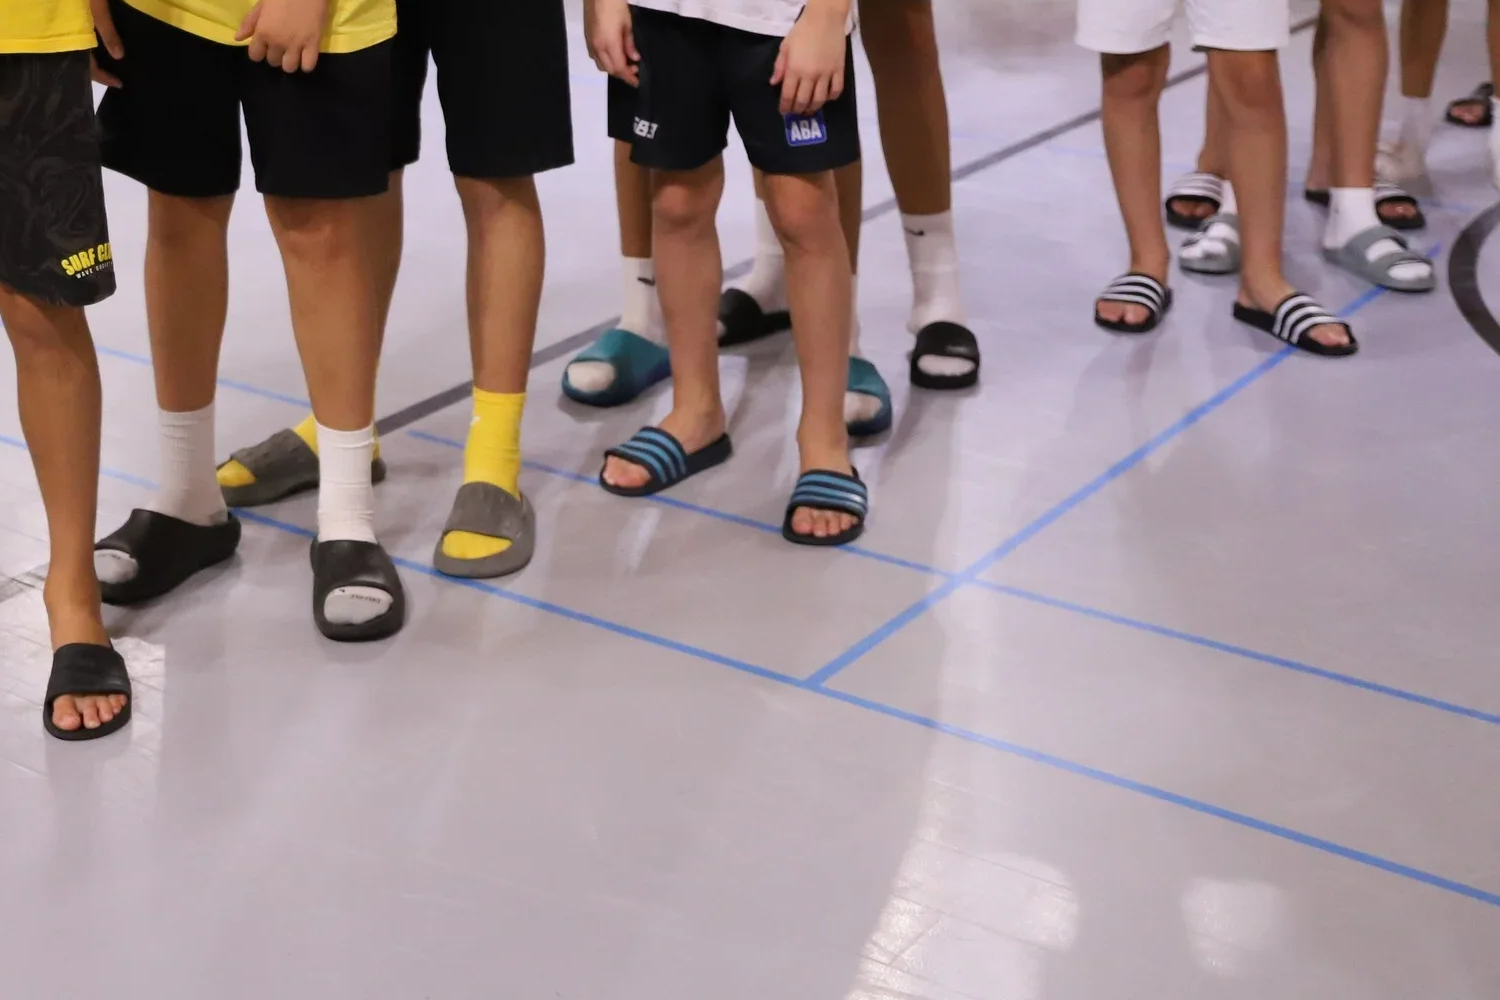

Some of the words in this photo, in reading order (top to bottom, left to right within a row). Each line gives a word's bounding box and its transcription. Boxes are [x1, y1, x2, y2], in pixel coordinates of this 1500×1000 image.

[790, 118, 822, 142] ABA
[61, 247, 96, 276] SURF
[75, 267, 94, 279] WAVE
